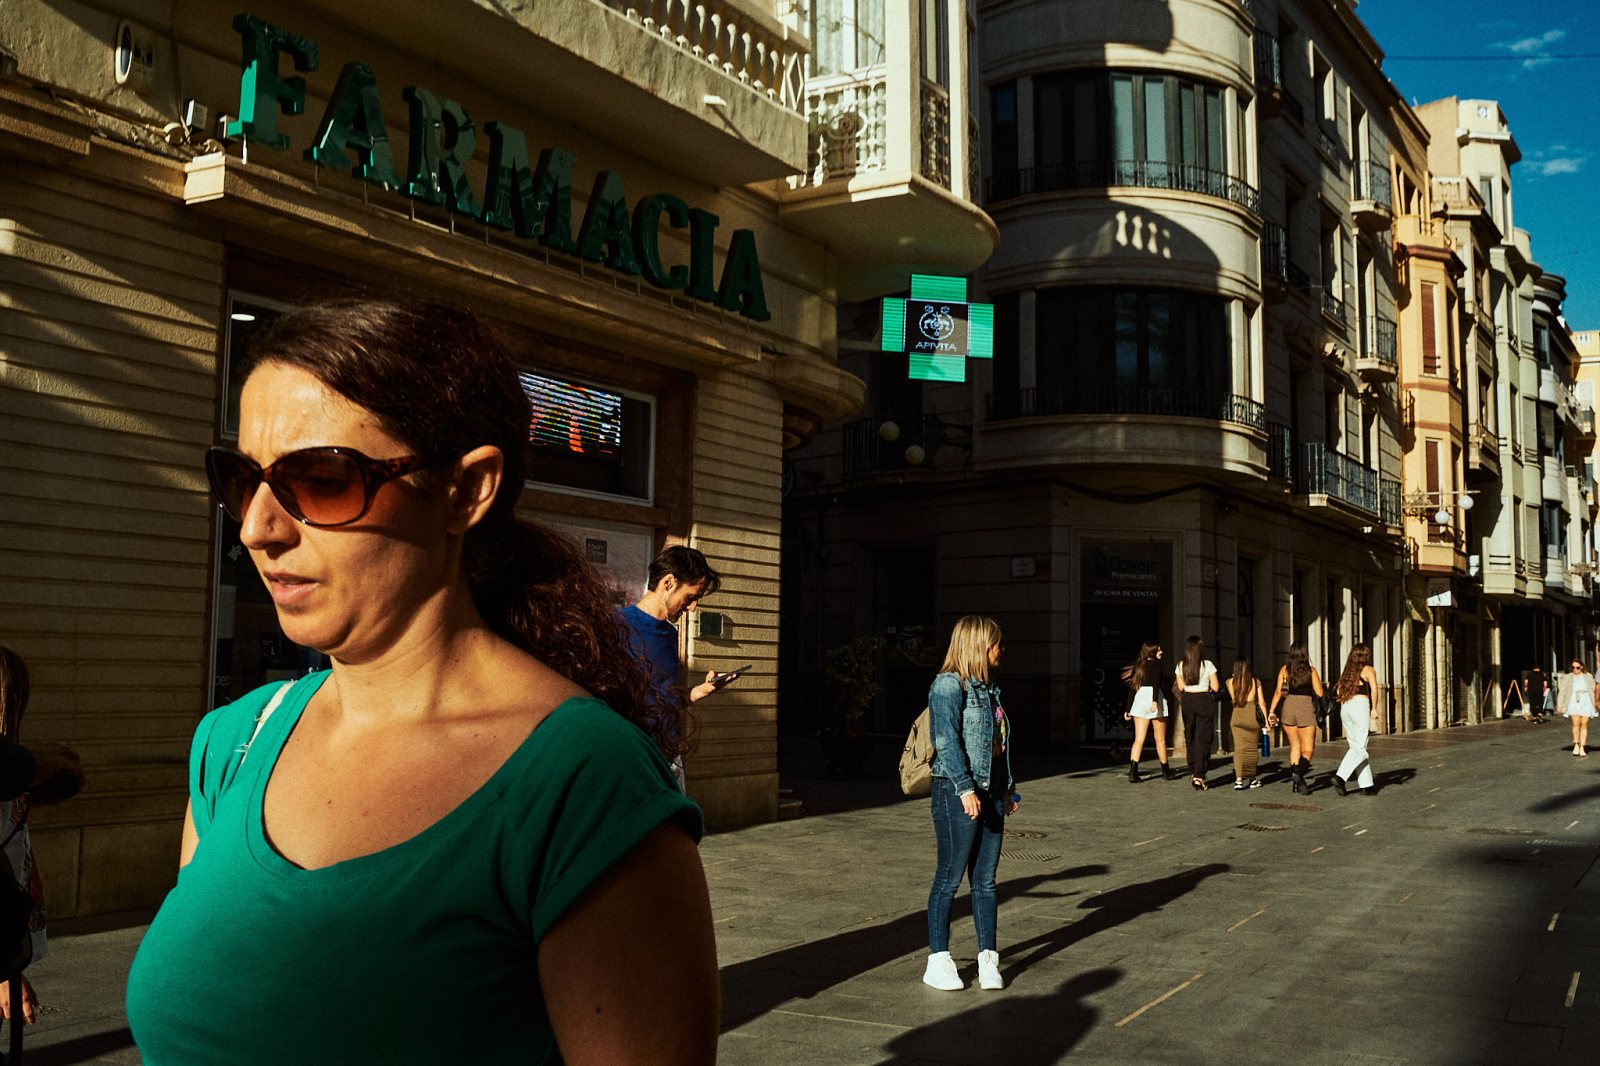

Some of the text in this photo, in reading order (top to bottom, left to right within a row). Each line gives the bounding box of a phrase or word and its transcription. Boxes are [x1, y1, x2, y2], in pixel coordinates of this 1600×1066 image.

[227, 13, 771, 322] FARMACIA
[915, 341, 957, 352] APIVITA
[1111, 572, 1157, 581] Promociones
[1094, 589, 1121, 597] OFICINA
[1132, 590, 1158, 598] VENTAS
